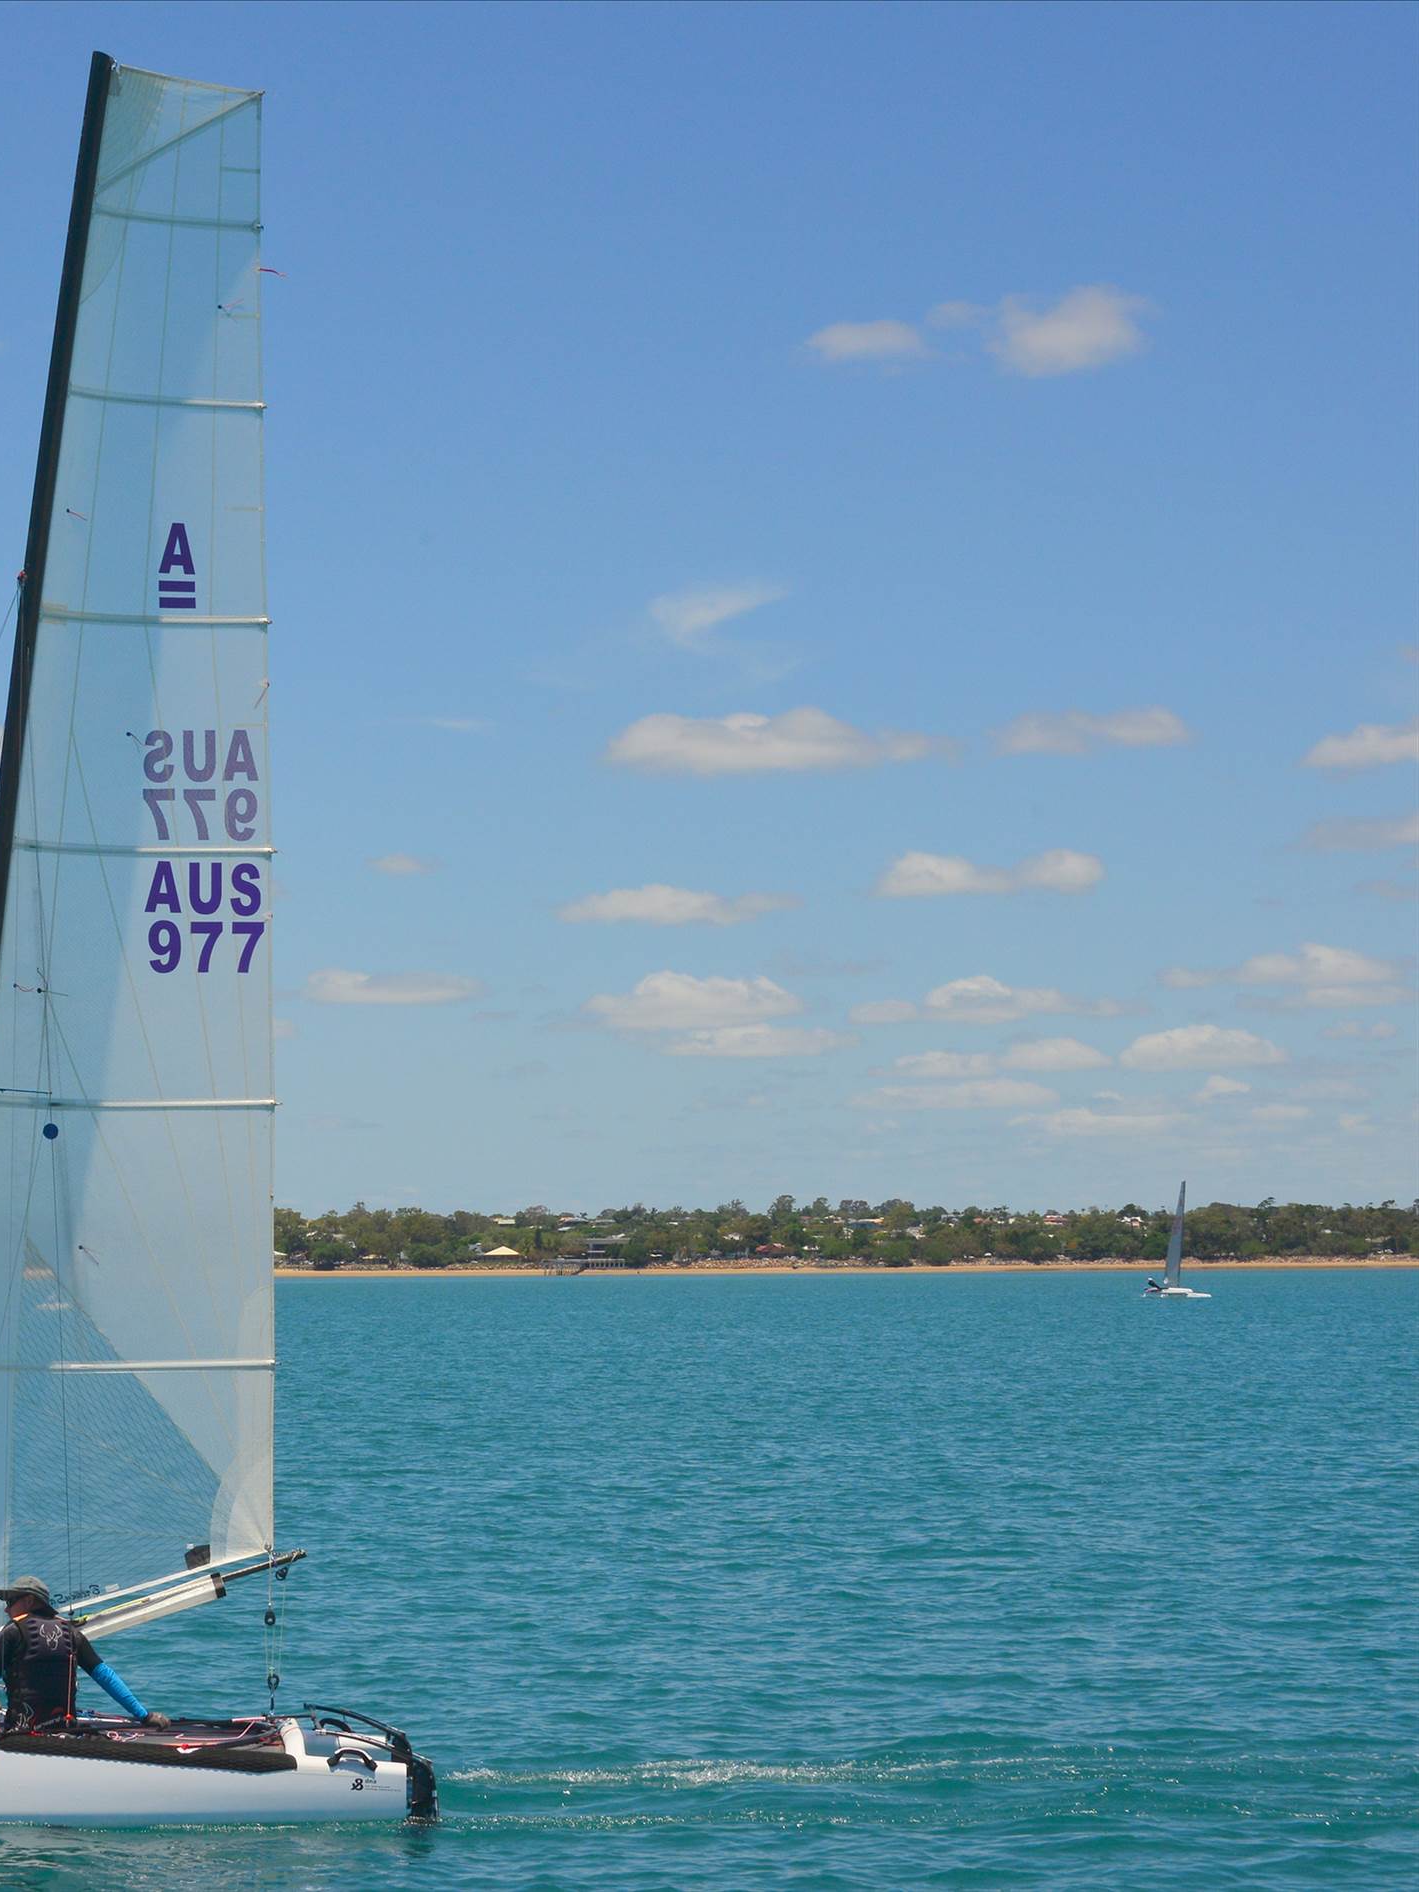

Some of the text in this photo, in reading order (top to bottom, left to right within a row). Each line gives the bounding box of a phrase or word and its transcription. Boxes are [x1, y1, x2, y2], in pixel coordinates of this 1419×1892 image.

[158, 522, 197, 575] A
[144, 860, 262, 917] AUS
[147, 919, 265, 974] 977
